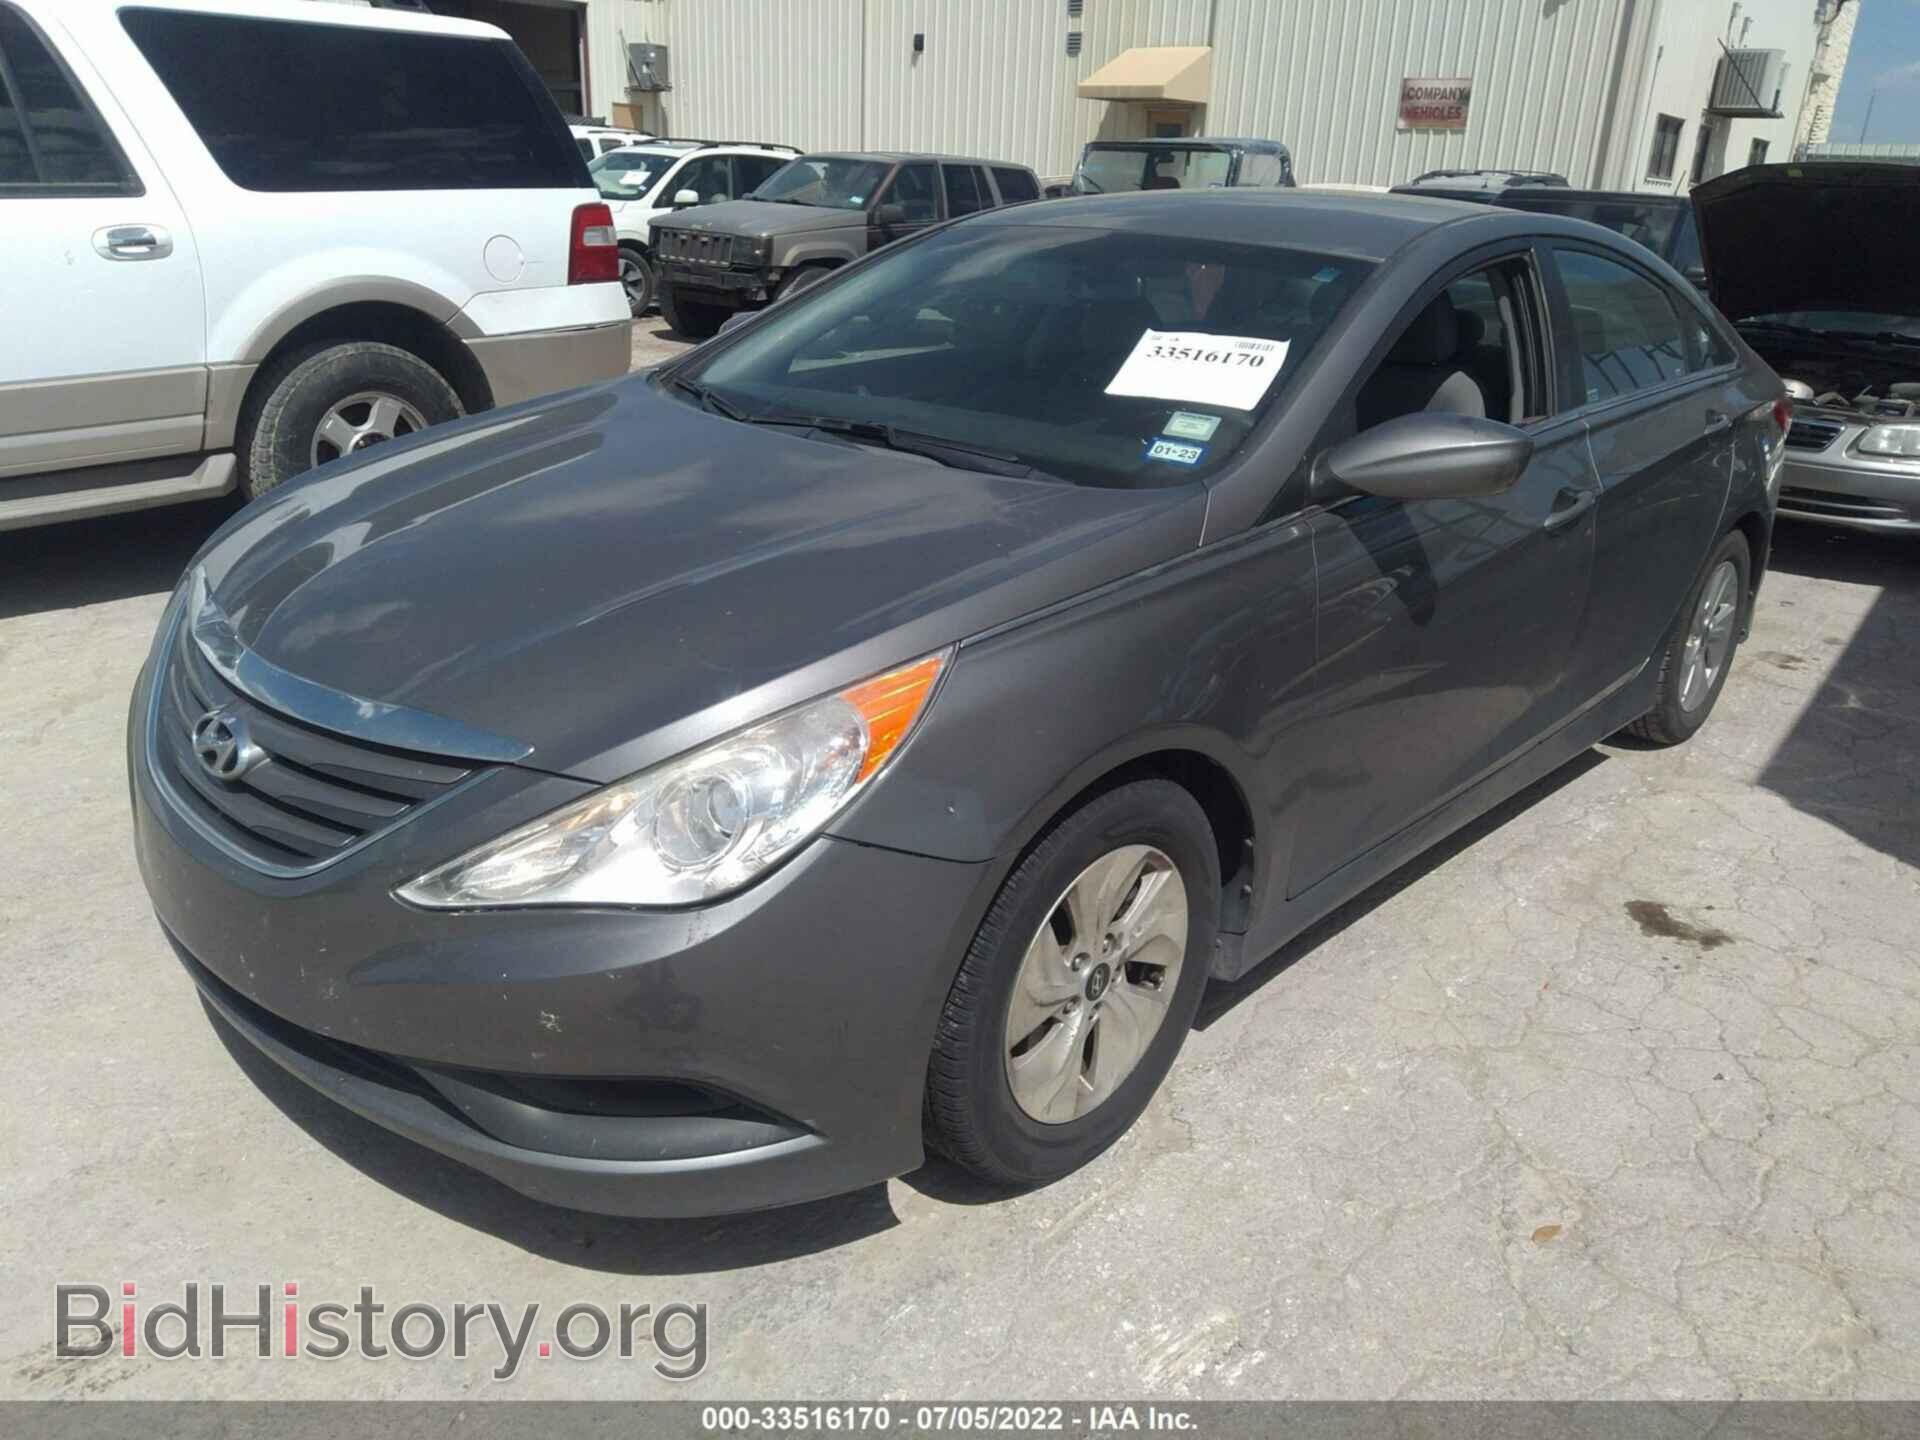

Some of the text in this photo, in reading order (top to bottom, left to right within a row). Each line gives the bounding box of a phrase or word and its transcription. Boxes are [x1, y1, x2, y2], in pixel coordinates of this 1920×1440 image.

[1407, 87, 1466, 100] COMPANY
[1404, 106, 1462, 120] VEHICLES
[1146, 345, 1265, 368] 33516170
[1154, 444, 1198, 460] 01-23
